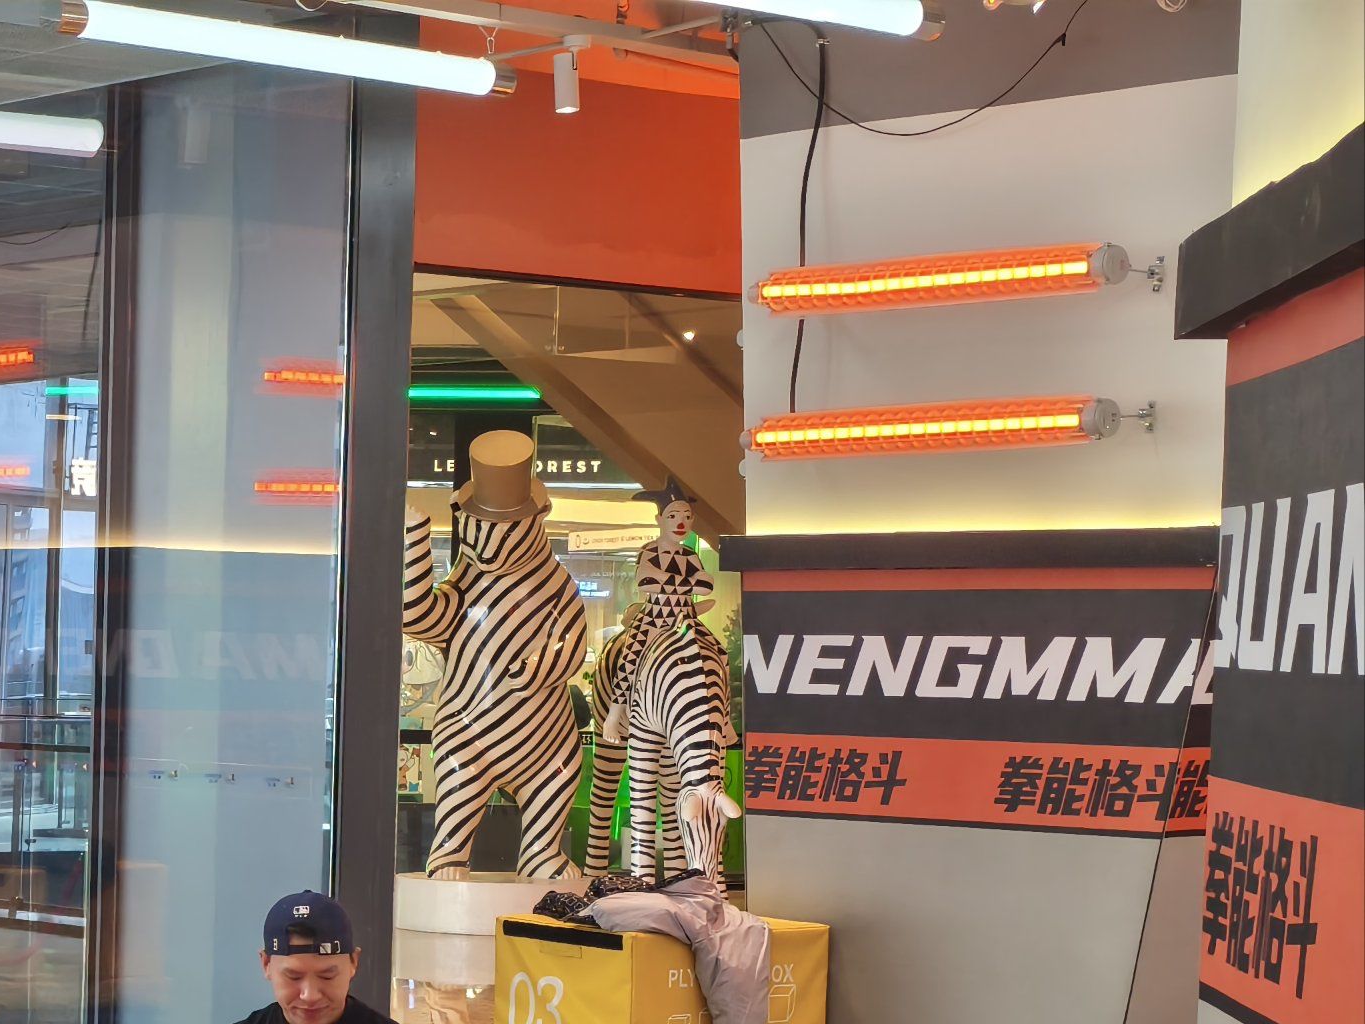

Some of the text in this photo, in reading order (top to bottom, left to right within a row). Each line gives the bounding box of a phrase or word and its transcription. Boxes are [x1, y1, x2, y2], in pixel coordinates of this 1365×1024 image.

[1214, 483, 1364, 675] QUAN
[744, 745, 907, 806] 拳能格斗
[1204, 811, 1319, 999] 拳能格斗
[668, 963, 794, 989] PLY OX
